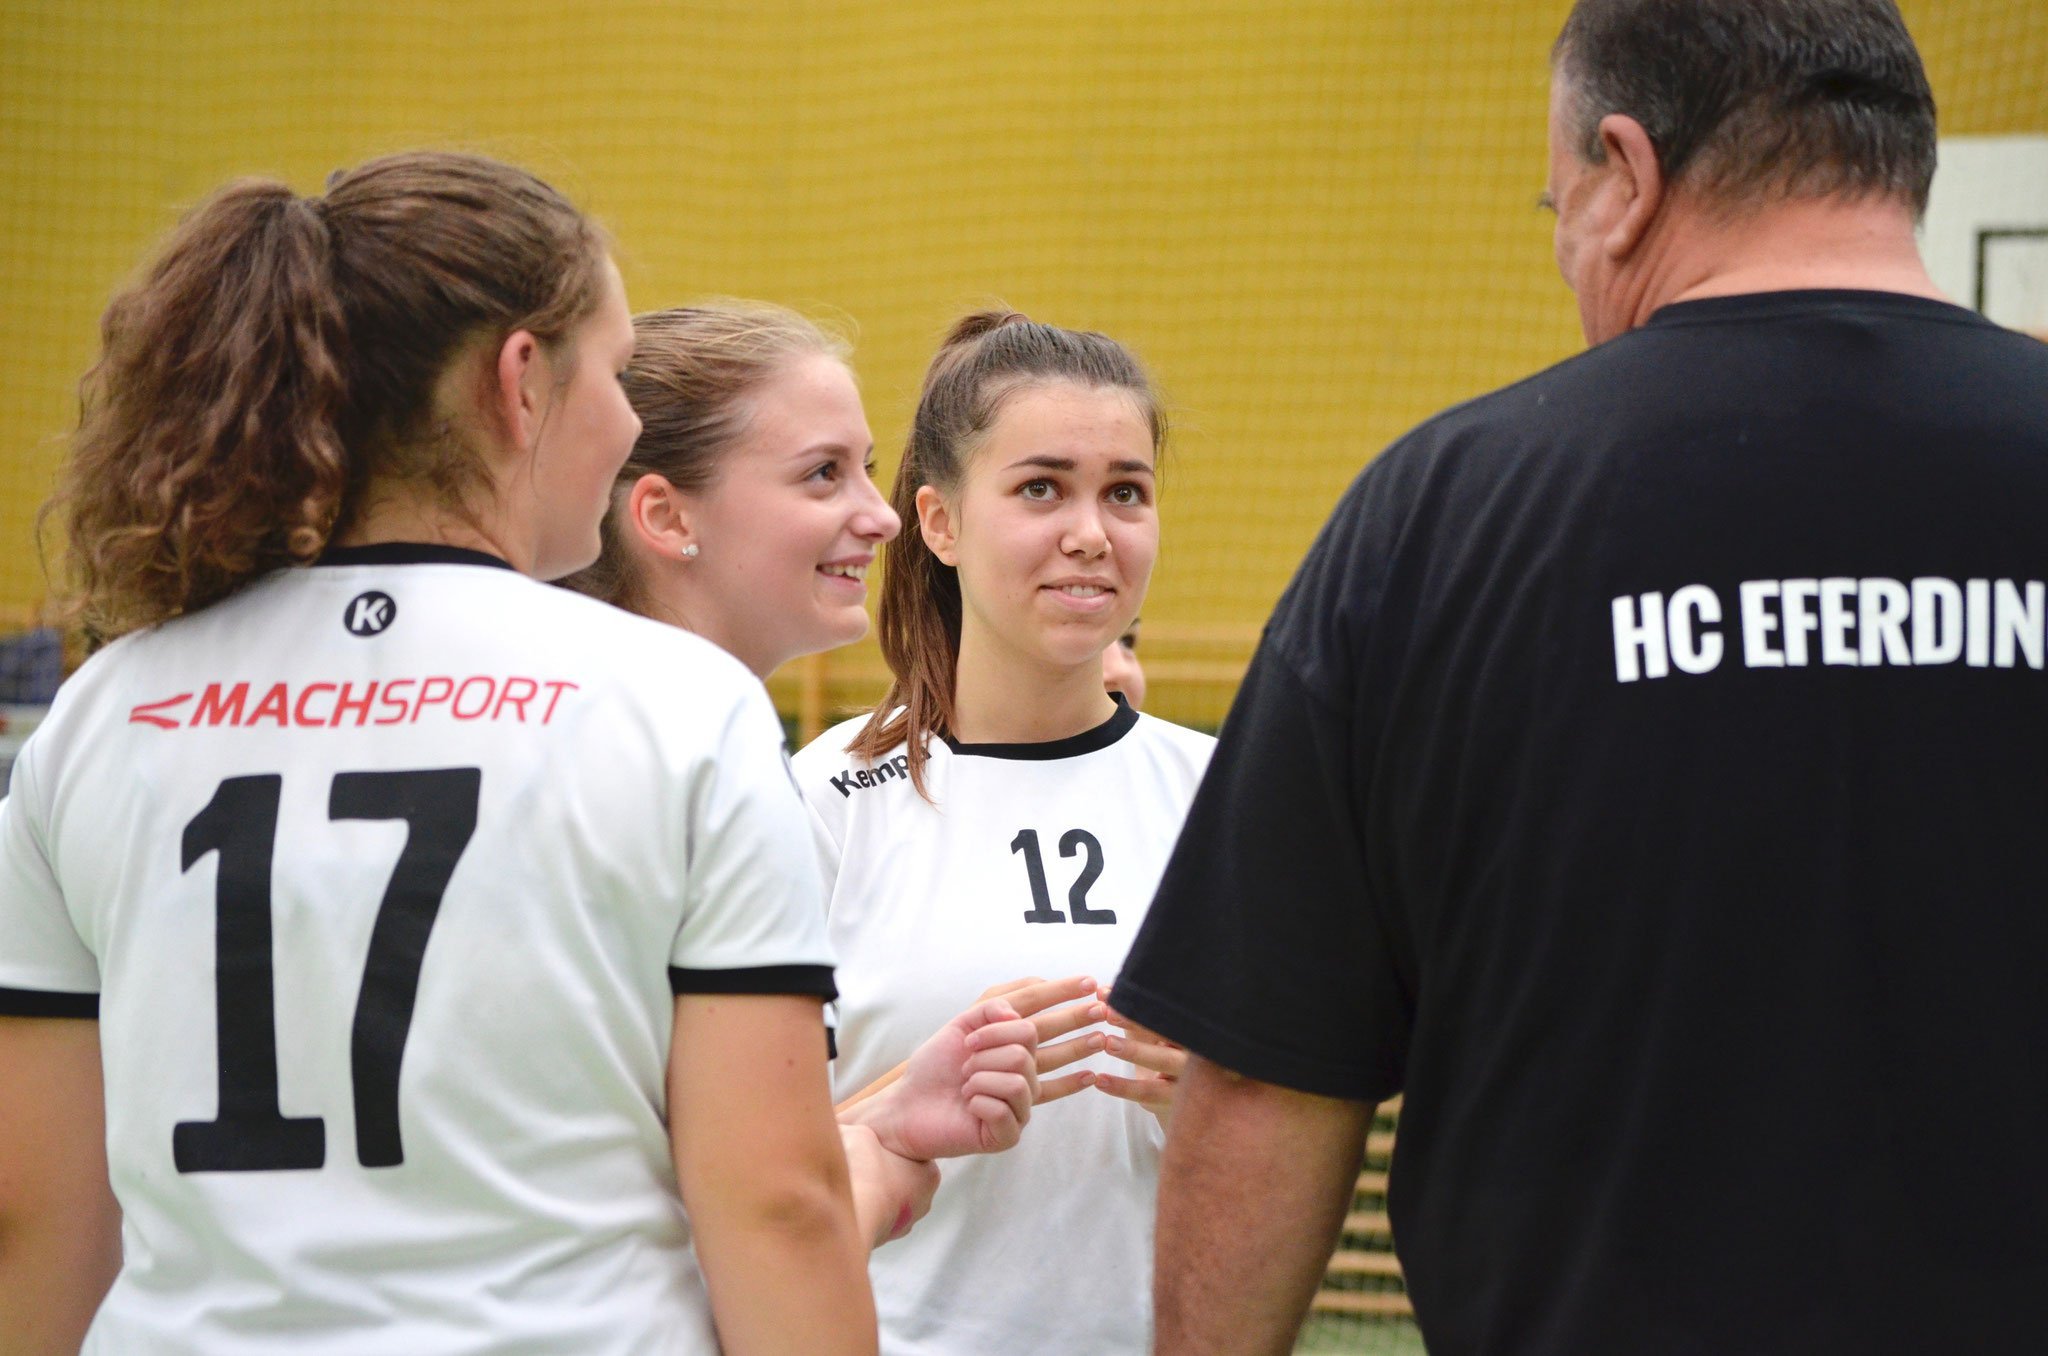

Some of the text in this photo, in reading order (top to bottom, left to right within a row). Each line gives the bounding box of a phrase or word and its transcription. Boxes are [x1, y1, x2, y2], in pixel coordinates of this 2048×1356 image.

[1611, 584, 1724, 683] HC
[188, 676, 579, 728] MACHSPORT
[1010, 828, 1117, 925] 12
[173, 767, 482, 1174] 17
